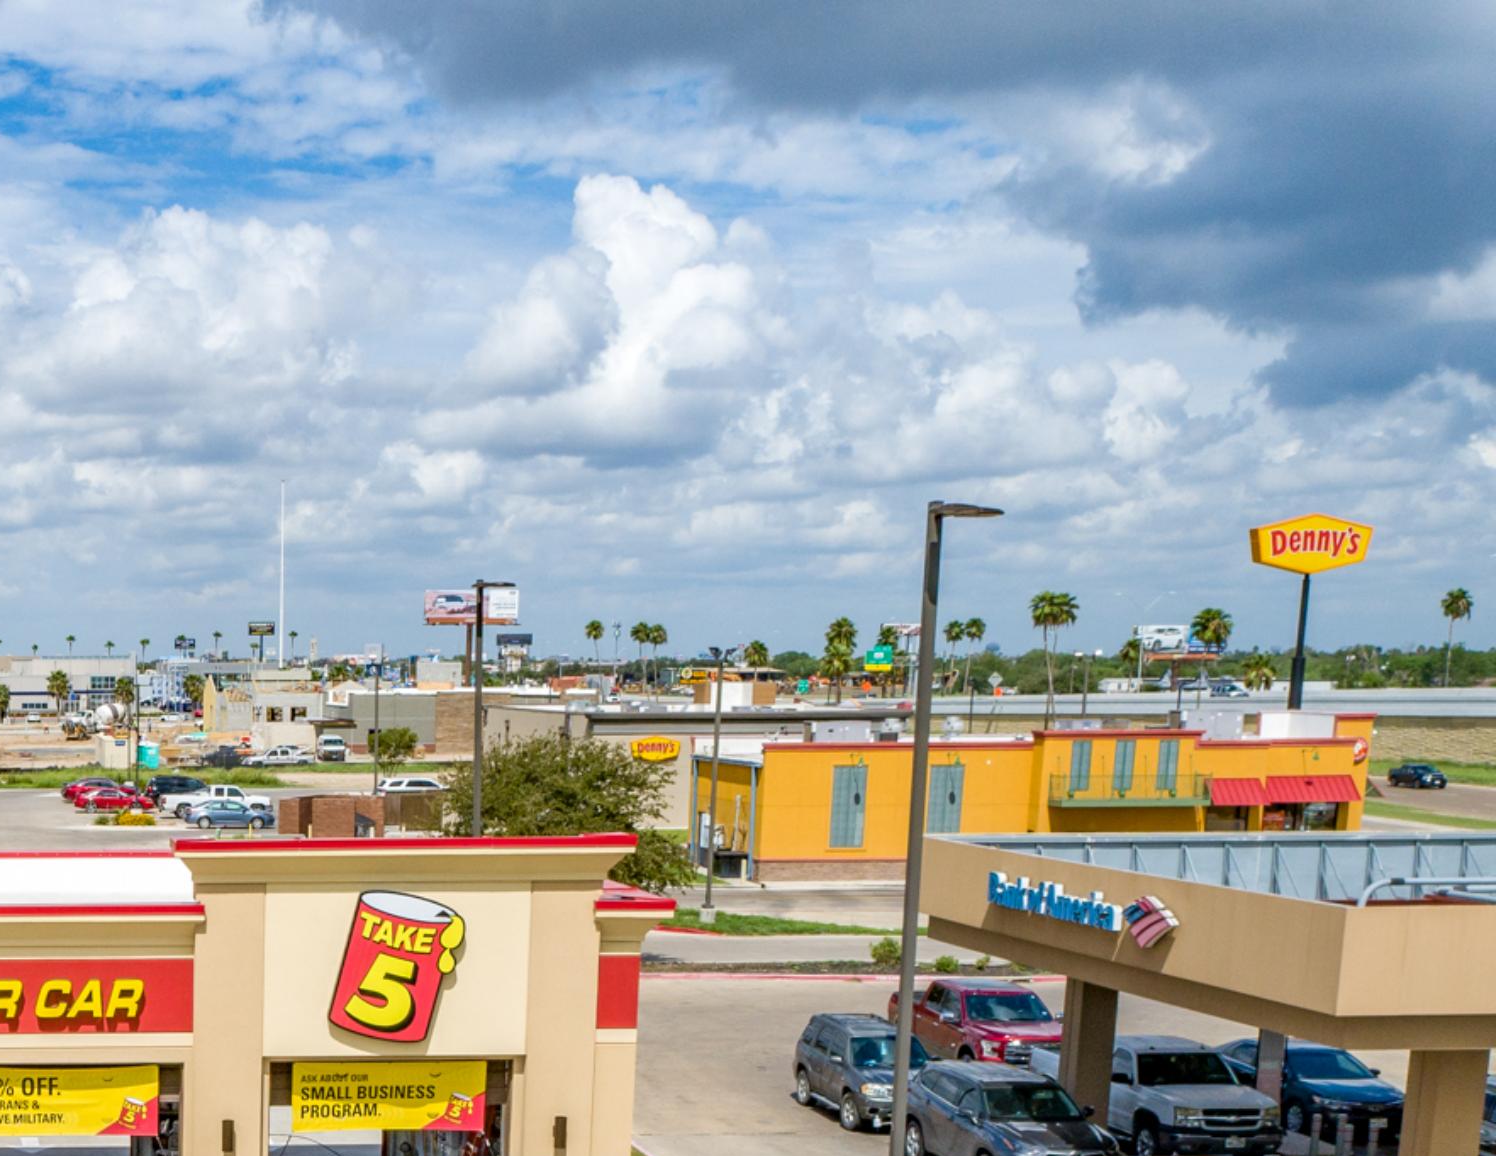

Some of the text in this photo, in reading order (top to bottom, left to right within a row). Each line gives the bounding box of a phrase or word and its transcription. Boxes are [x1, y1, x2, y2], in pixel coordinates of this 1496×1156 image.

[1270, 526, 1360, 558] Denny's
[637, 743, 675, 754] Denny's
[988, 871, 1028, 911] Bank
[1047, 883, 1123, 932] America
[360, 911, 437, 954] TAKE
[35, 979, 144, 1019] CAR
[344, 952, 418, 1031] 5
[21, 1077, 61, 1096] OFF.
[301, 1073, 368, 1083] ASK ABOUT OUR
[301, 1084, 436, 1101] SMALL BUSINESS
[31, 1101, 40, 1110] &
[301, 1103, 382, 1119] PROGRAM.
